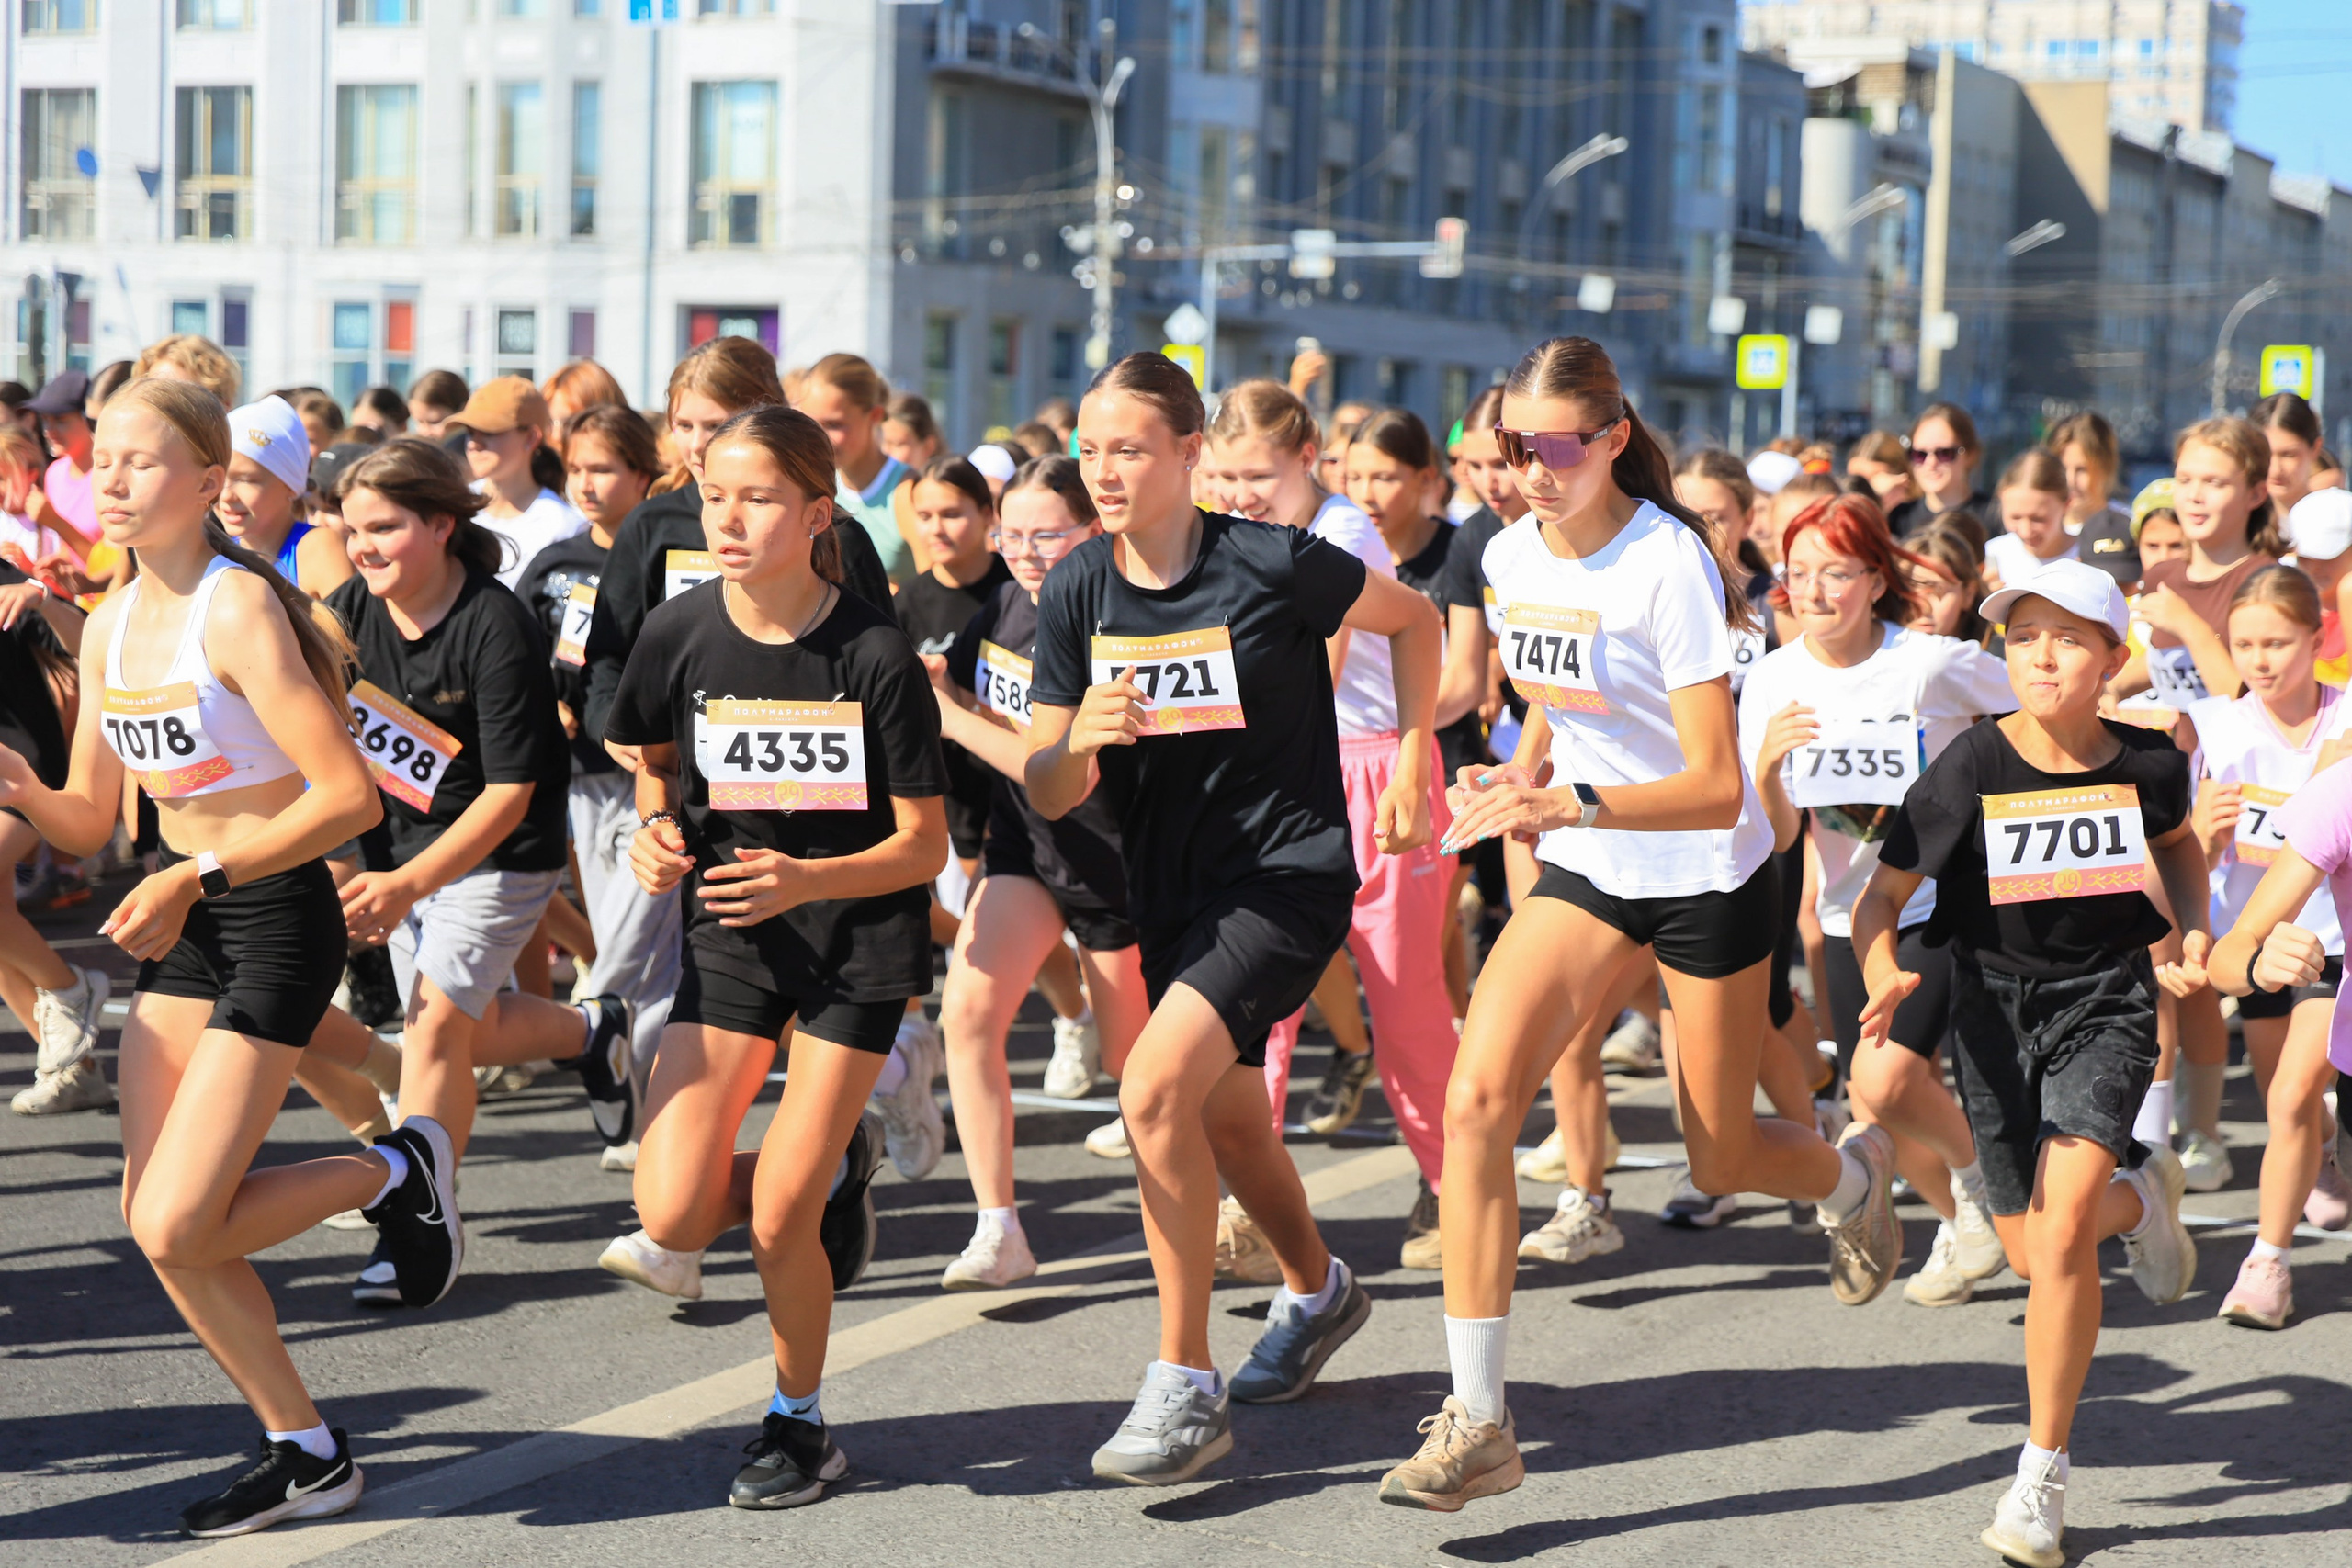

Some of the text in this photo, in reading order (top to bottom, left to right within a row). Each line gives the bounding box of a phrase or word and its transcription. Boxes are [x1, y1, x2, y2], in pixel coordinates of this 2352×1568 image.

[1510, 630, 1581, 679] 7474
[733, 707, 828, 716] ПОЛУМАРАФОН
[107, 716, 197, 761] 7078
[723, 731, 850, 773] 4335
[1806, 748, 1905, 779] 7335
[2004, 815, 2128, 864] 7701
